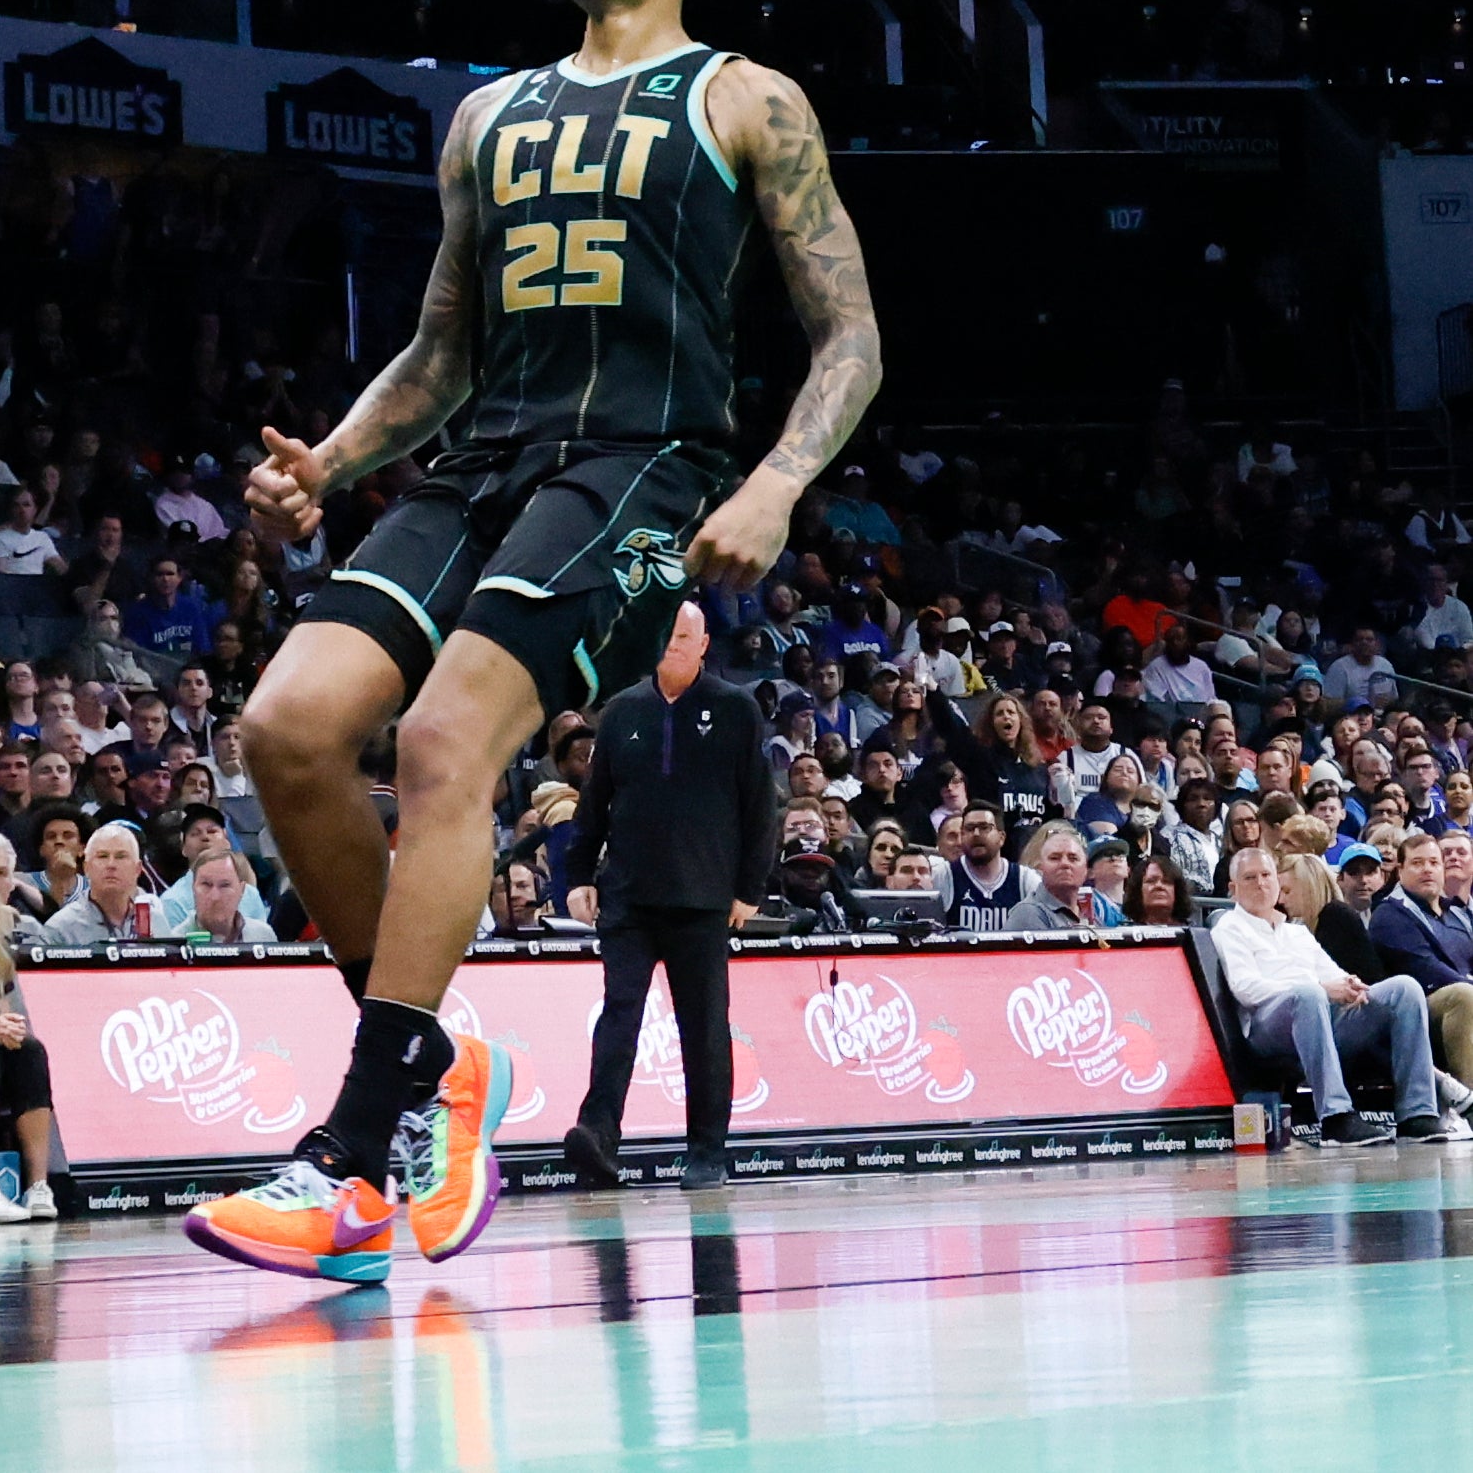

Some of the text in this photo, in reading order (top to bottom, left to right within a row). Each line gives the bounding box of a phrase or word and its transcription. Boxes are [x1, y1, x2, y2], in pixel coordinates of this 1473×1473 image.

[23, 70, 167, 136] LOWE'S
[284, 99, 417, 162] LOWE'S
[493, 113, 672, 207] CLT
[1107, 209, 1143, 230] 107
[501, 220, 628, 313] 25
[960, 905, 1007, 932] MAV
[834, 981, 874, 1027] Dr
[1033, 975, 1071, 1020] Dr
[138, 996, 189, 1046] Dr
[974, 1147, 1021, 1162] lendingtree
[1031, 1144, 1077, 1159] lendingtree
[1087, 1141, 1133, 1156] lendingtree
[1143, 1138, 1187, 1153] lendingtree
[735, 1159, 784, 1173] lendingtree
[796, 1156, 846, 1171] lendingtree
[857, 1153, 905, 1167] lendingtree
[916, 1150, 964, 1165] lendingtree
[521, 1170, 576, 1188] lendingtree
[88, 1191, 150, 1212] lendingtree
